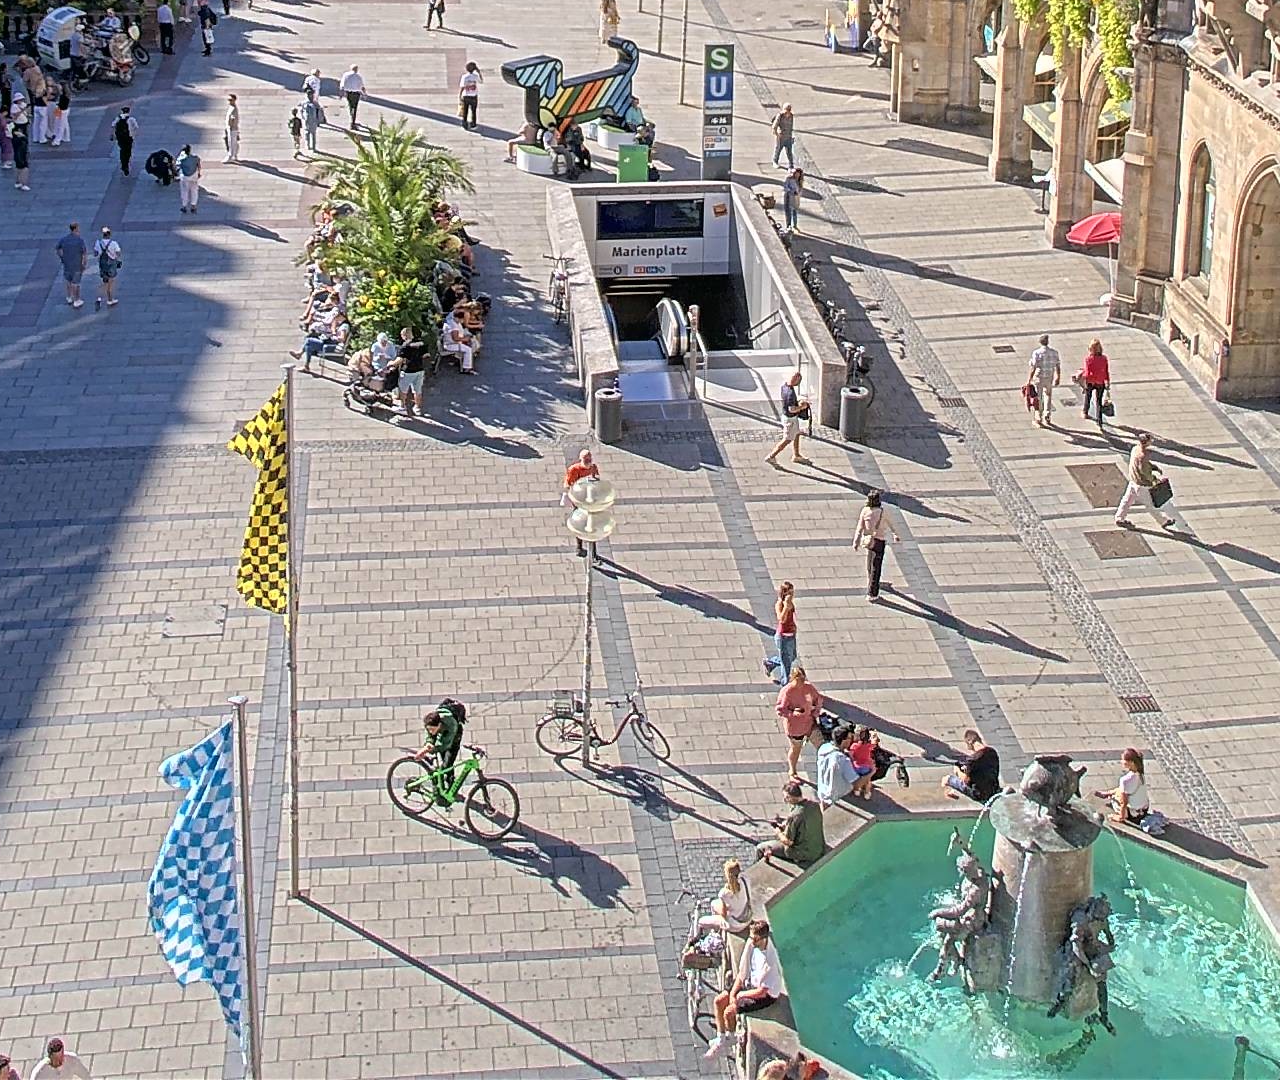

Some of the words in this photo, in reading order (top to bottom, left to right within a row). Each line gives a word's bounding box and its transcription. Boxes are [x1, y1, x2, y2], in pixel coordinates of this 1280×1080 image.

[710, 47, 729, 70] S
[710, 76, 727, 97] U
[612, 245, 688, 258] Marienplatz
